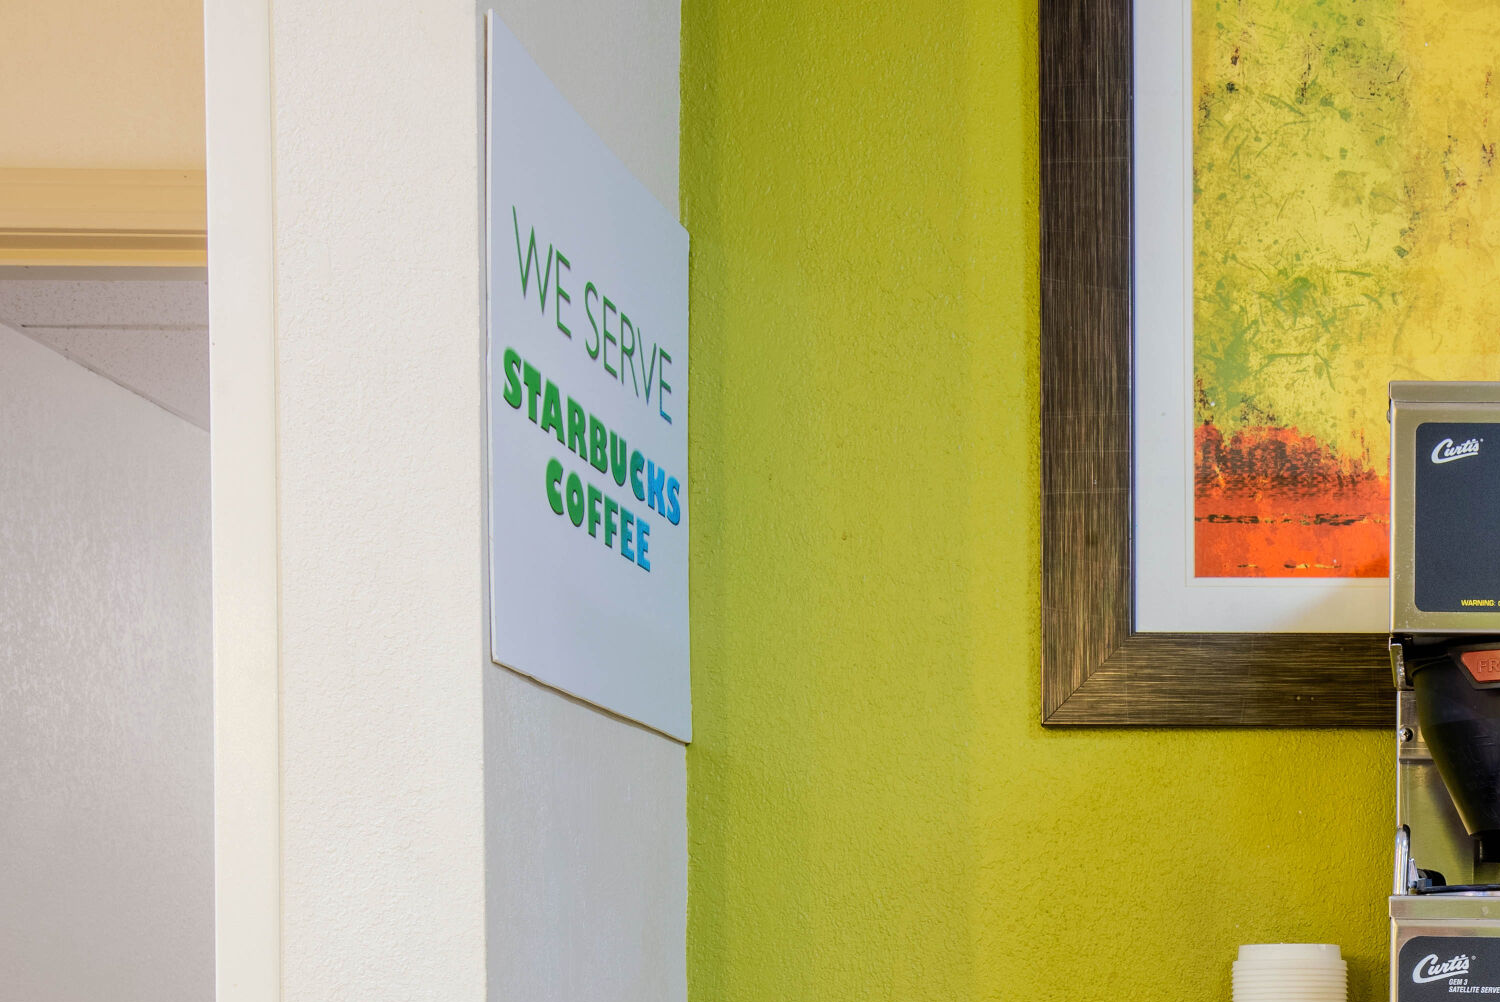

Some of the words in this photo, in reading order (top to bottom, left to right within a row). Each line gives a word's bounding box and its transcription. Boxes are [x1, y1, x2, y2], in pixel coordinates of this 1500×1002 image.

[513, 205, 571, 339] WE
[585, 281, 672, 424] SERVE
[503, 346, 680, 526] STARBUCKS
[1431, 438, 1479, 464] Curtis
[546, 457, 651, 572] COFFEE
[1412, 954, 1469, 983] Curtis
